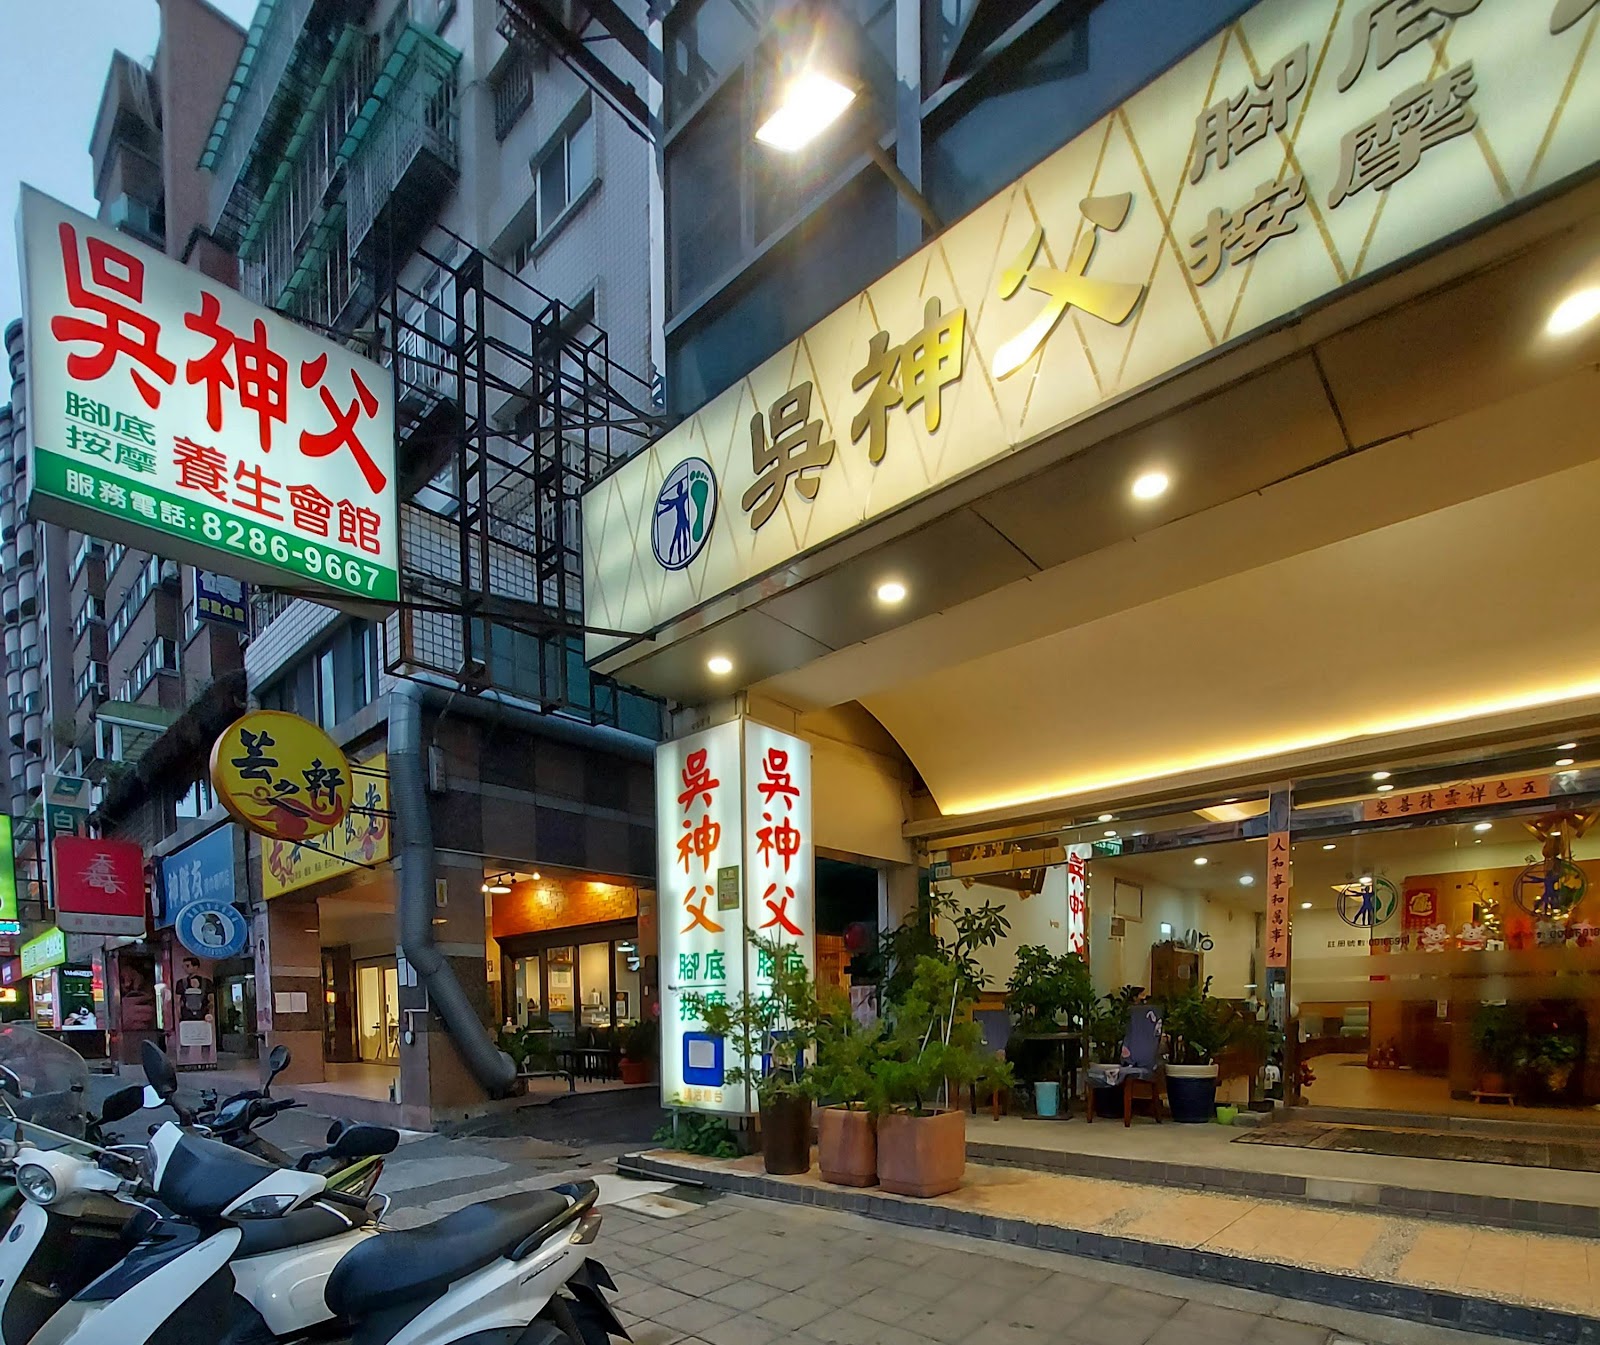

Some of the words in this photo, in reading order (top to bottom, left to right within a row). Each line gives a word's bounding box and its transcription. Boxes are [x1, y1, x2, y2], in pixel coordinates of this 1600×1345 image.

[1190, 58, 1480, 286] 按摩
[51, 221, 387, 494] 吳神父
[65, 391, 157, 446] 腳底
[66, 425, 158, 475] 按摩
[740, 192, 1146, 530] 吳神父
[173, 435, 380, 556] 養生會館
[676, 748, 724, 933] 吳神父
[756, 748, 804, 936] 吳神父
[678, 949, 726, 981] 腳底
